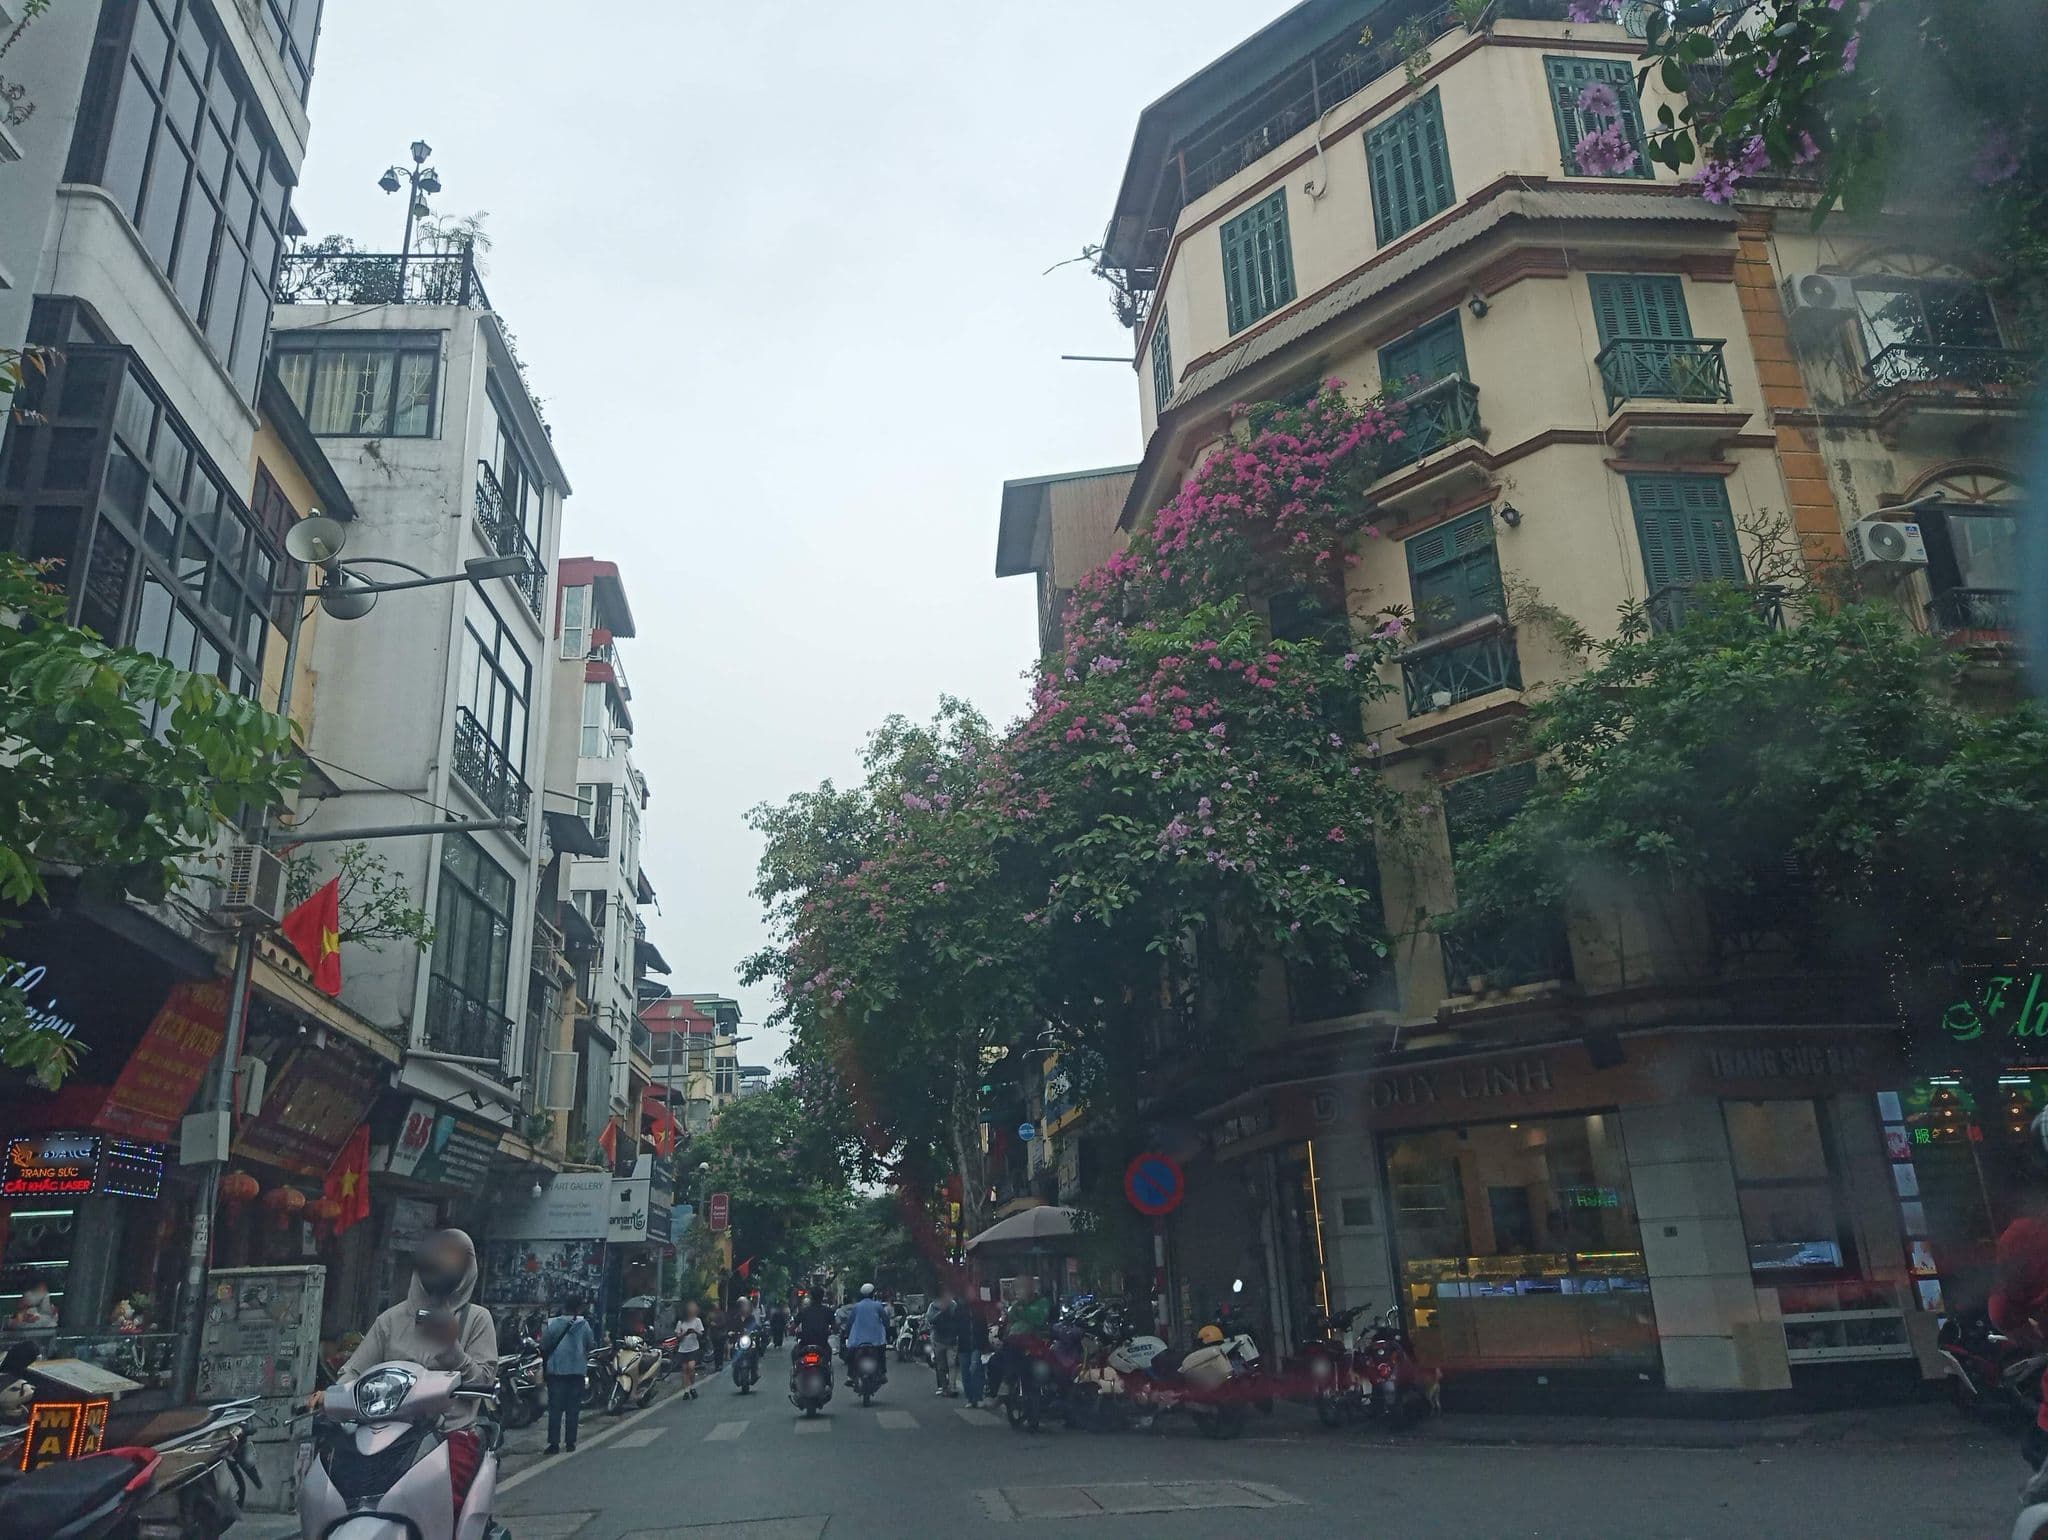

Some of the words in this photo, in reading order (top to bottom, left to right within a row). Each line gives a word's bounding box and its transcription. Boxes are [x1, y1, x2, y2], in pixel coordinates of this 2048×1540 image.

[1457, 1058, 1554, 1099] LINH
[20, 1168, 55, 1178] TRANG
[60, 1180, 91, 1190] LASER
[571, 1182, 603, 1191] GALLERY
